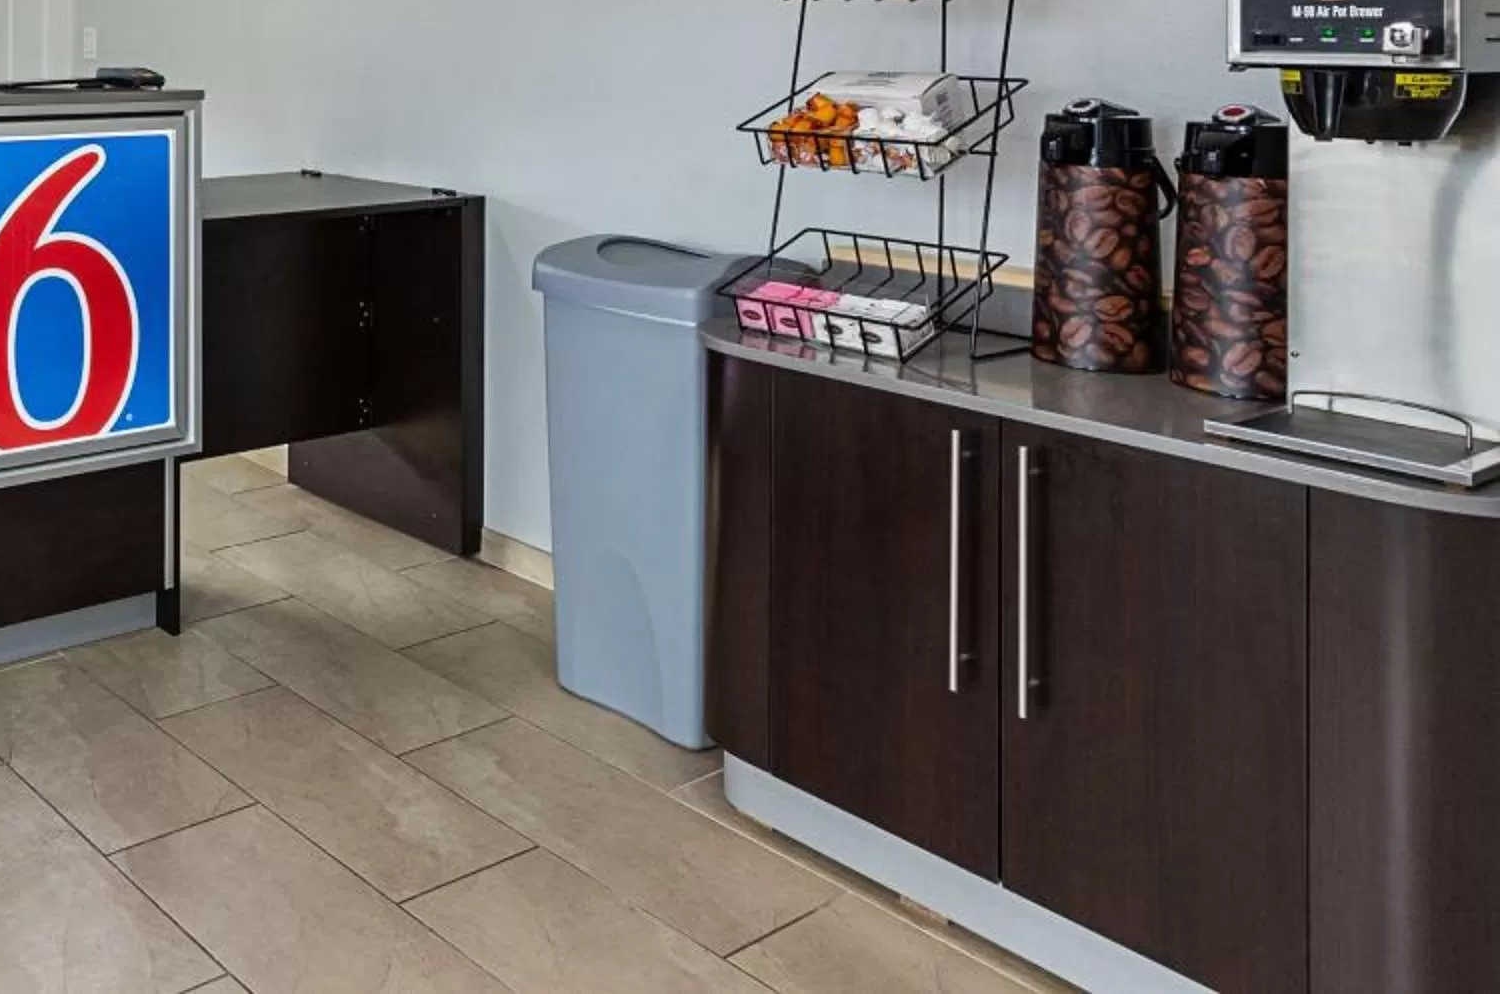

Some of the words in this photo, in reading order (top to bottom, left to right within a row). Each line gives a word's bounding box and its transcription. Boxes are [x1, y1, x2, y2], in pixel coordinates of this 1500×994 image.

[1315, 5, 1331, 18] Air
[1332, 5, 1348, 18] Pot
[1349, 5, 1384, 18] Brewer
